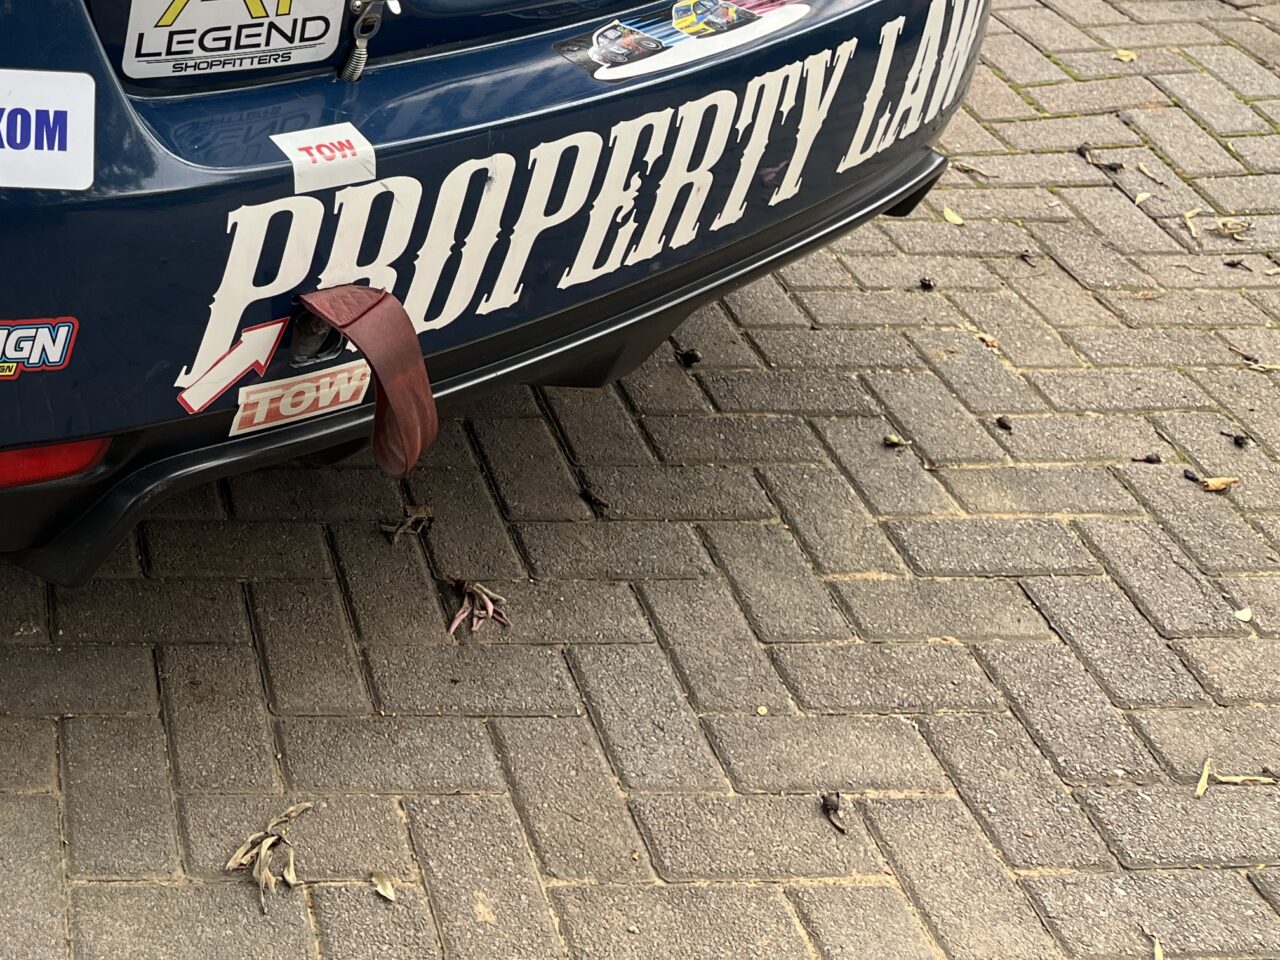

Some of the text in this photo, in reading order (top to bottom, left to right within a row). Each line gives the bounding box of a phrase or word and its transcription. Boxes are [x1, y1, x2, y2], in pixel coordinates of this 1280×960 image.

[134, 15, 331, 58] LEGEND
[171, 52, 292, 73] SHOPFITTERS
[298, 139, 358, 164] TOW
[174, 36, 859, 388] PROPERTY
[247, 369, 366, 426] TOW
